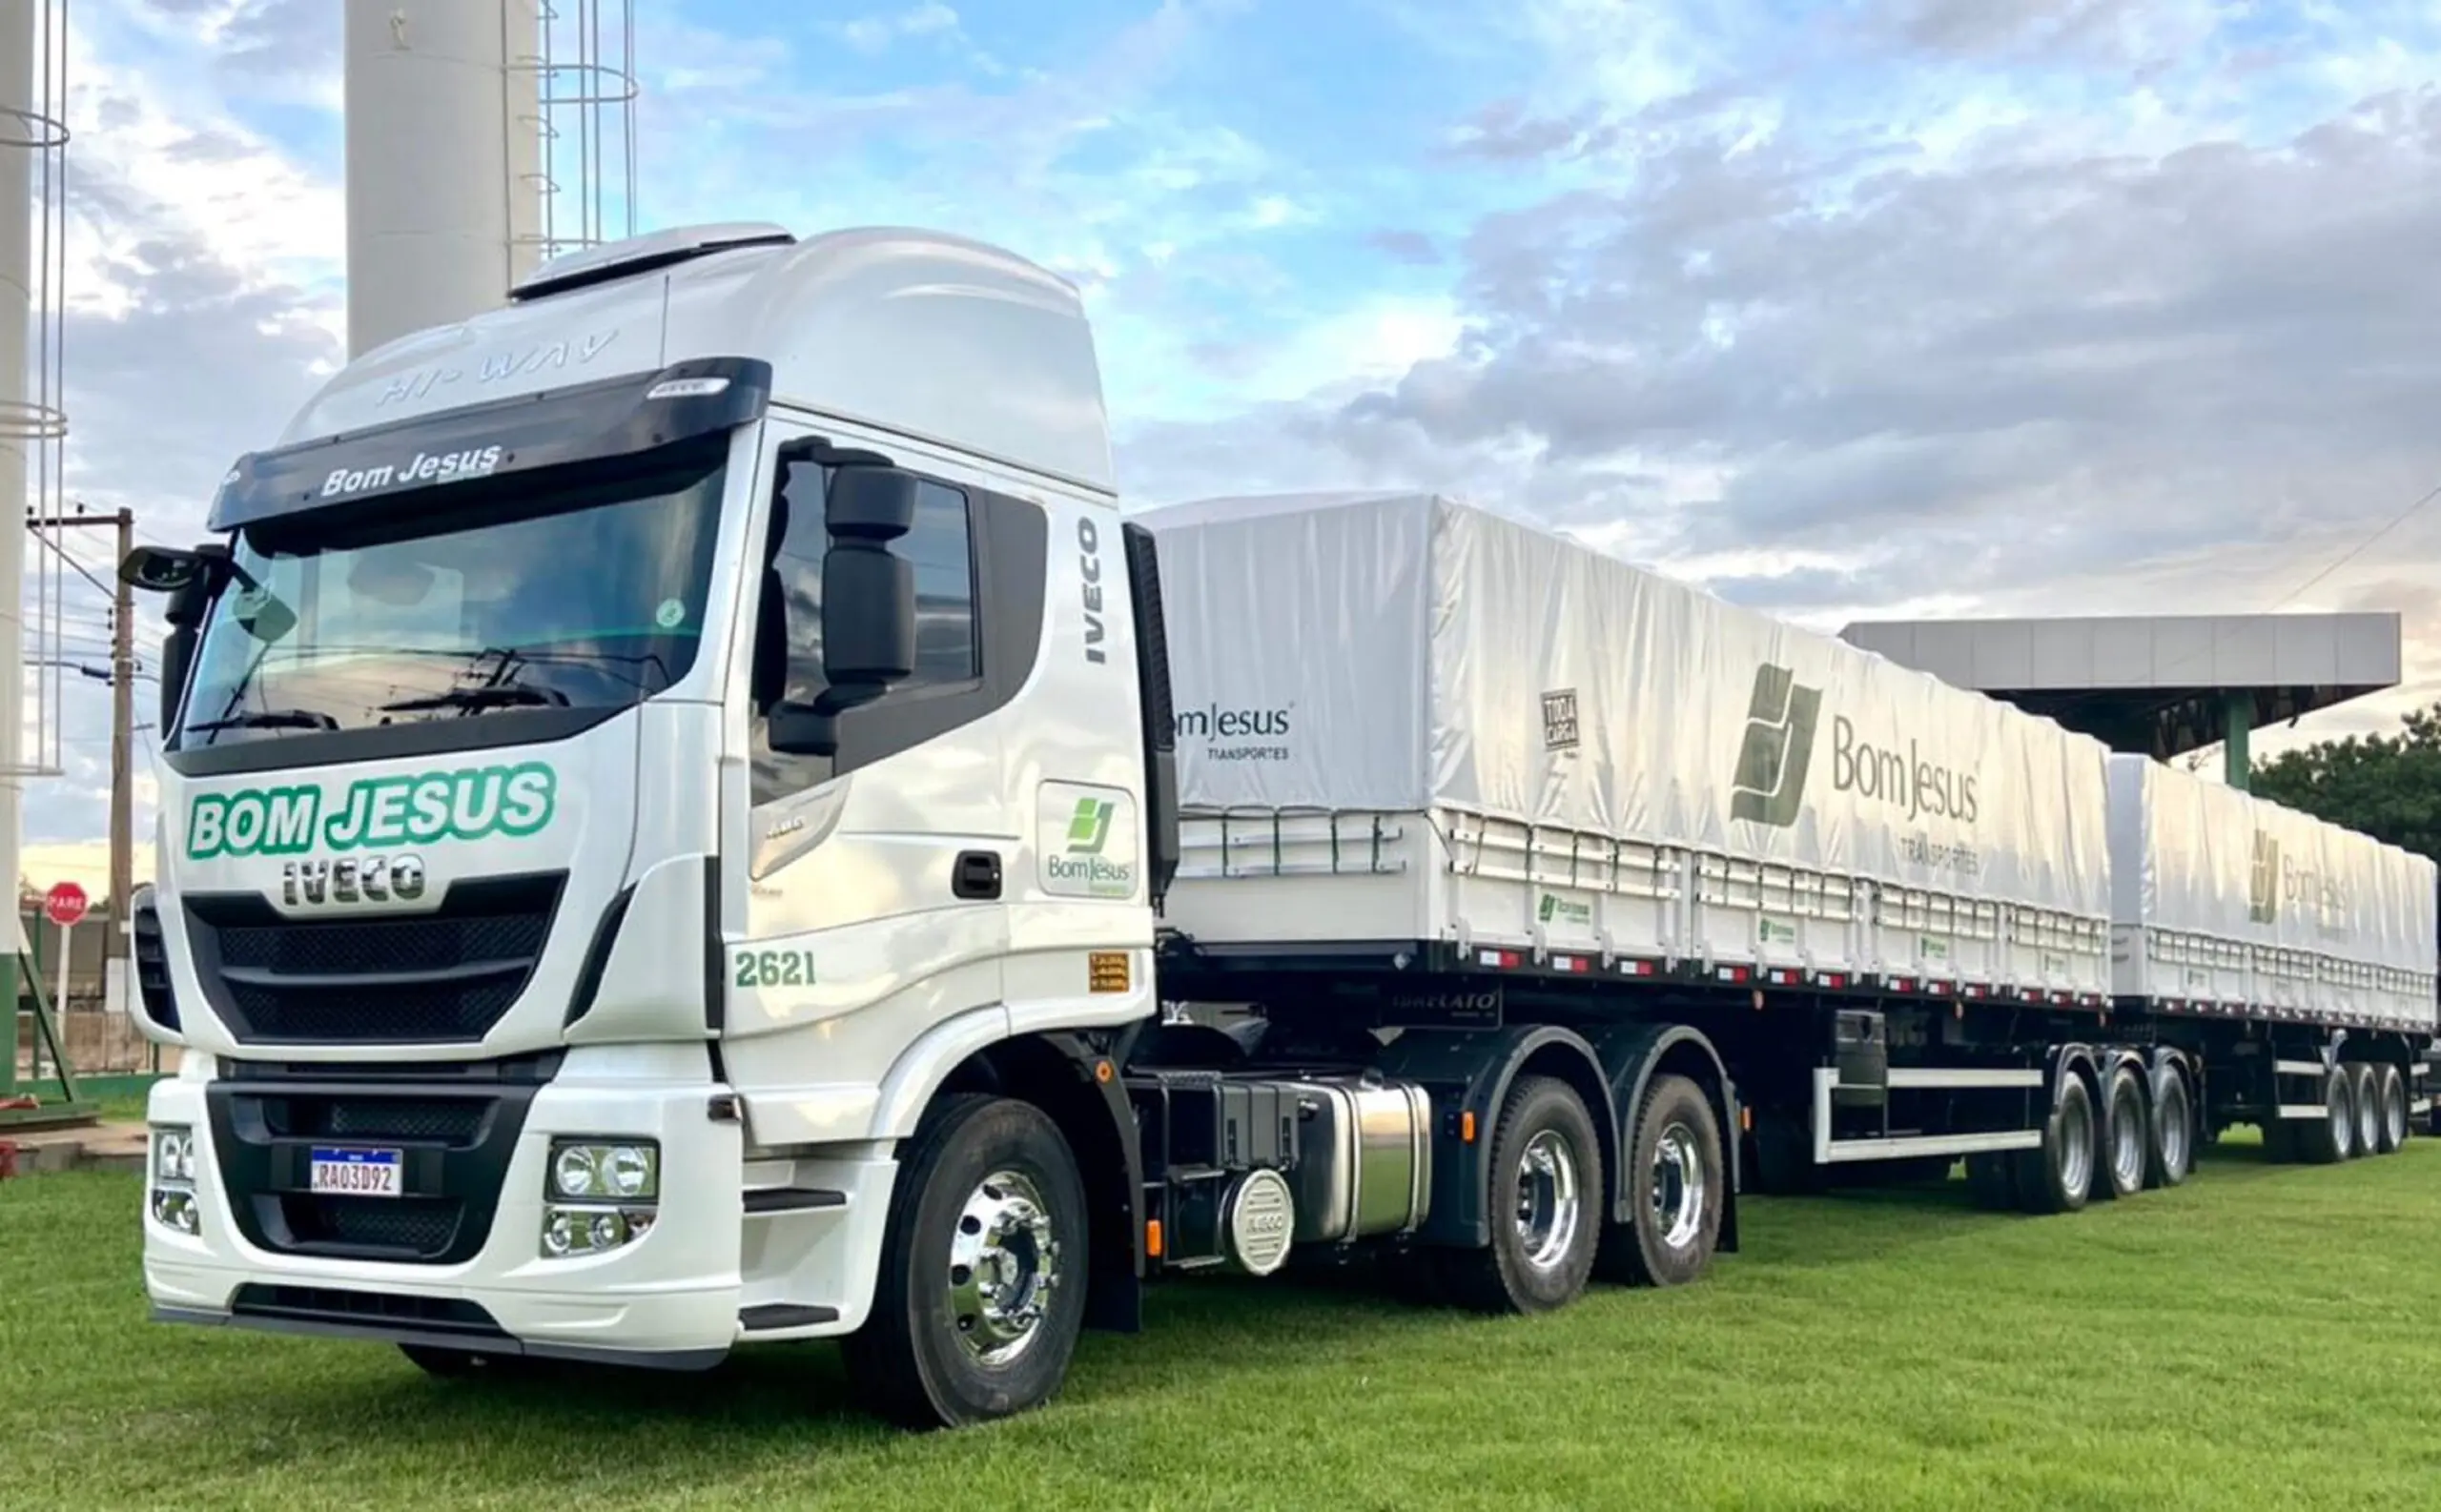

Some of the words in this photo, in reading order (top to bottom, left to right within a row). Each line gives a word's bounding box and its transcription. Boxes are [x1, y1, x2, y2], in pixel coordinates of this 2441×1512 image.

[320, 465, 395, 497] Bom
[398, 444, 502, 482] Jesus
[1077, 516, 1106, 664] IVECO
[1173, 702, 1289, 742] mJesus
[1207, 747, 1288, 760] TRANSPORTES
[1834, 713, 1978, 824] BomJesus
[189, 787, 319, 856] BOM
[326, 763, 555, 849] JESUS
[283, 853, 425, 906] IVECO
[1048, 854, 1130, 881] BomJesus
[49, 895, 84, 909] PARE
[735, 950, 816, 988] 2621
